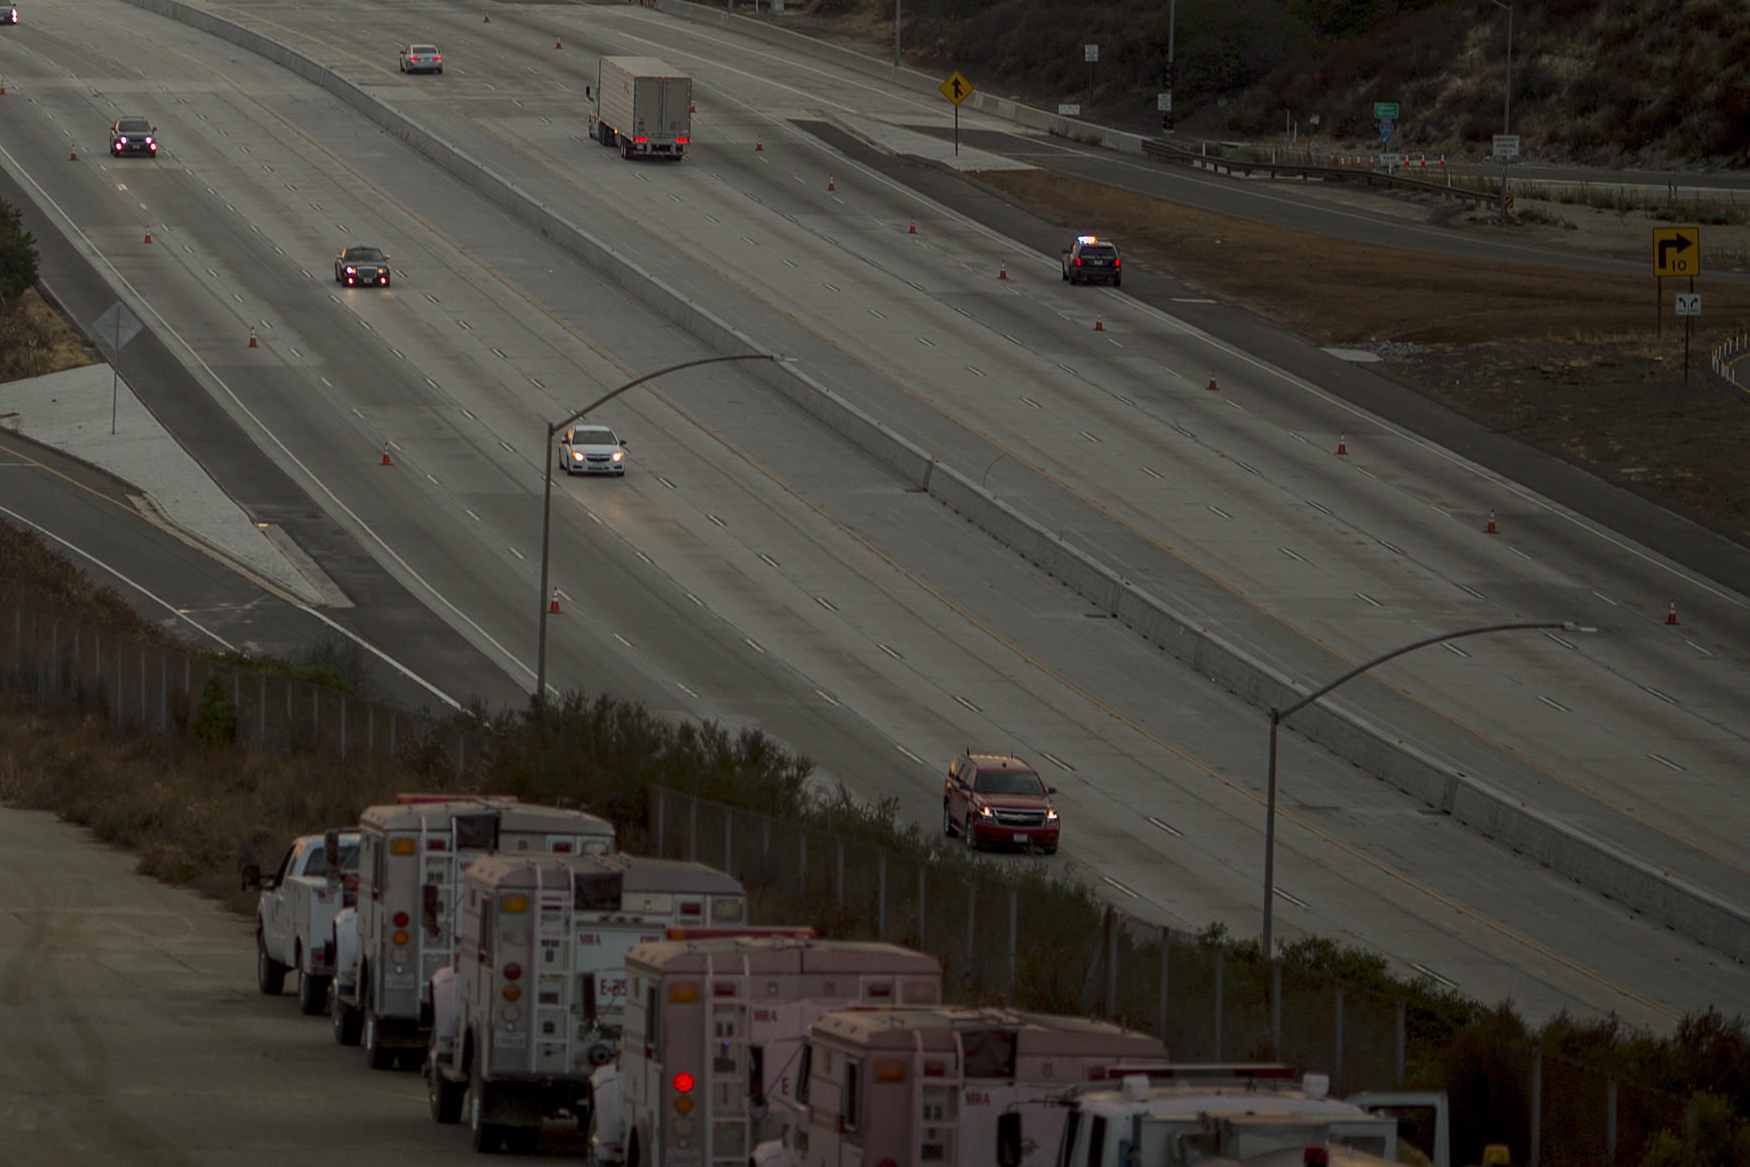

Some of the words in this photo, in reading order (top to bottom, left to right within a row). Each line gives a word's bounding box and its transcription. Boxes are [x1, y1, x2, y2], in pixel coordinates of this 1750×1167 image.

[1672, 260, 1687, 271] 10
[580, 934, 601, 946] MRA
[754, 1009, 777, 1022] MRA
[965, 1092, 991, 1106] MRA
